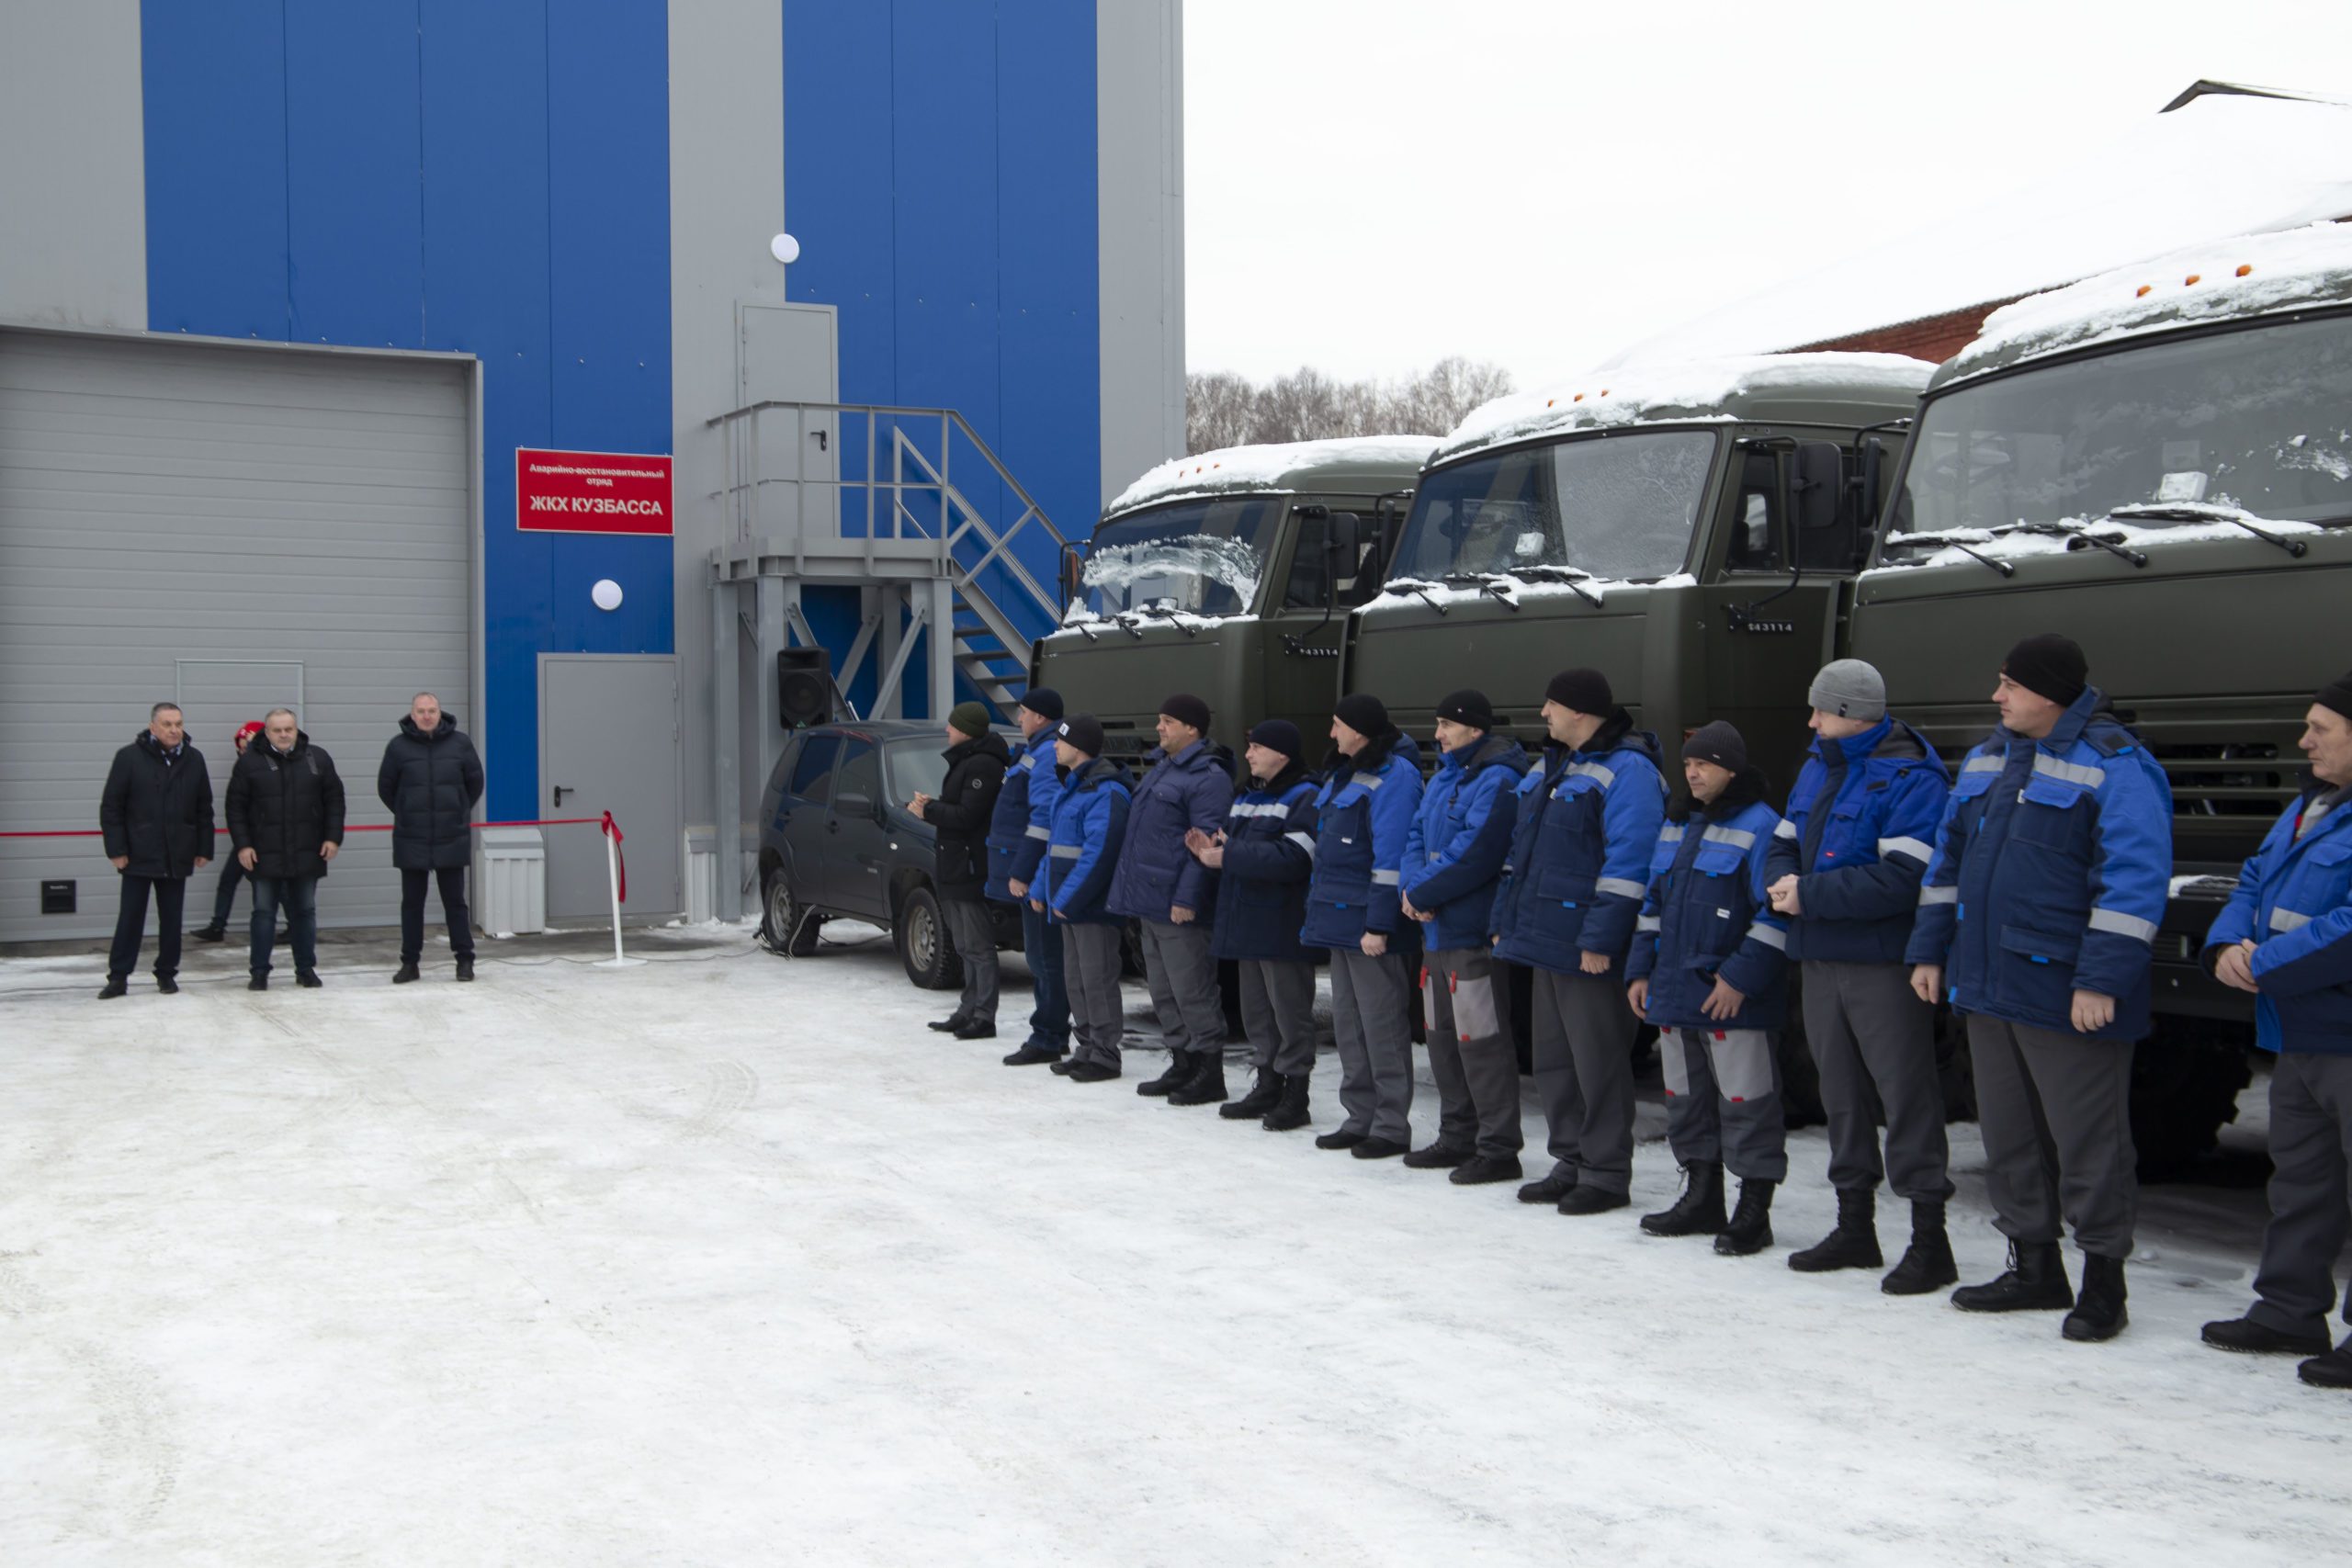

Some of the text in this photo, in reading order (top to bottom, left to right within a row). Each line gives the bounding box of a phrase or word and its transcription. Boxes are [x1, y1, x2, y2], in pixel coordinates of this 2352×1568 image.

[529, 463, 665, 479] Аварийно-восстановительный
[586, 478, 614, 487] отряд
[529, 495, 663, 516] ЖКХ КУЗБАССА
